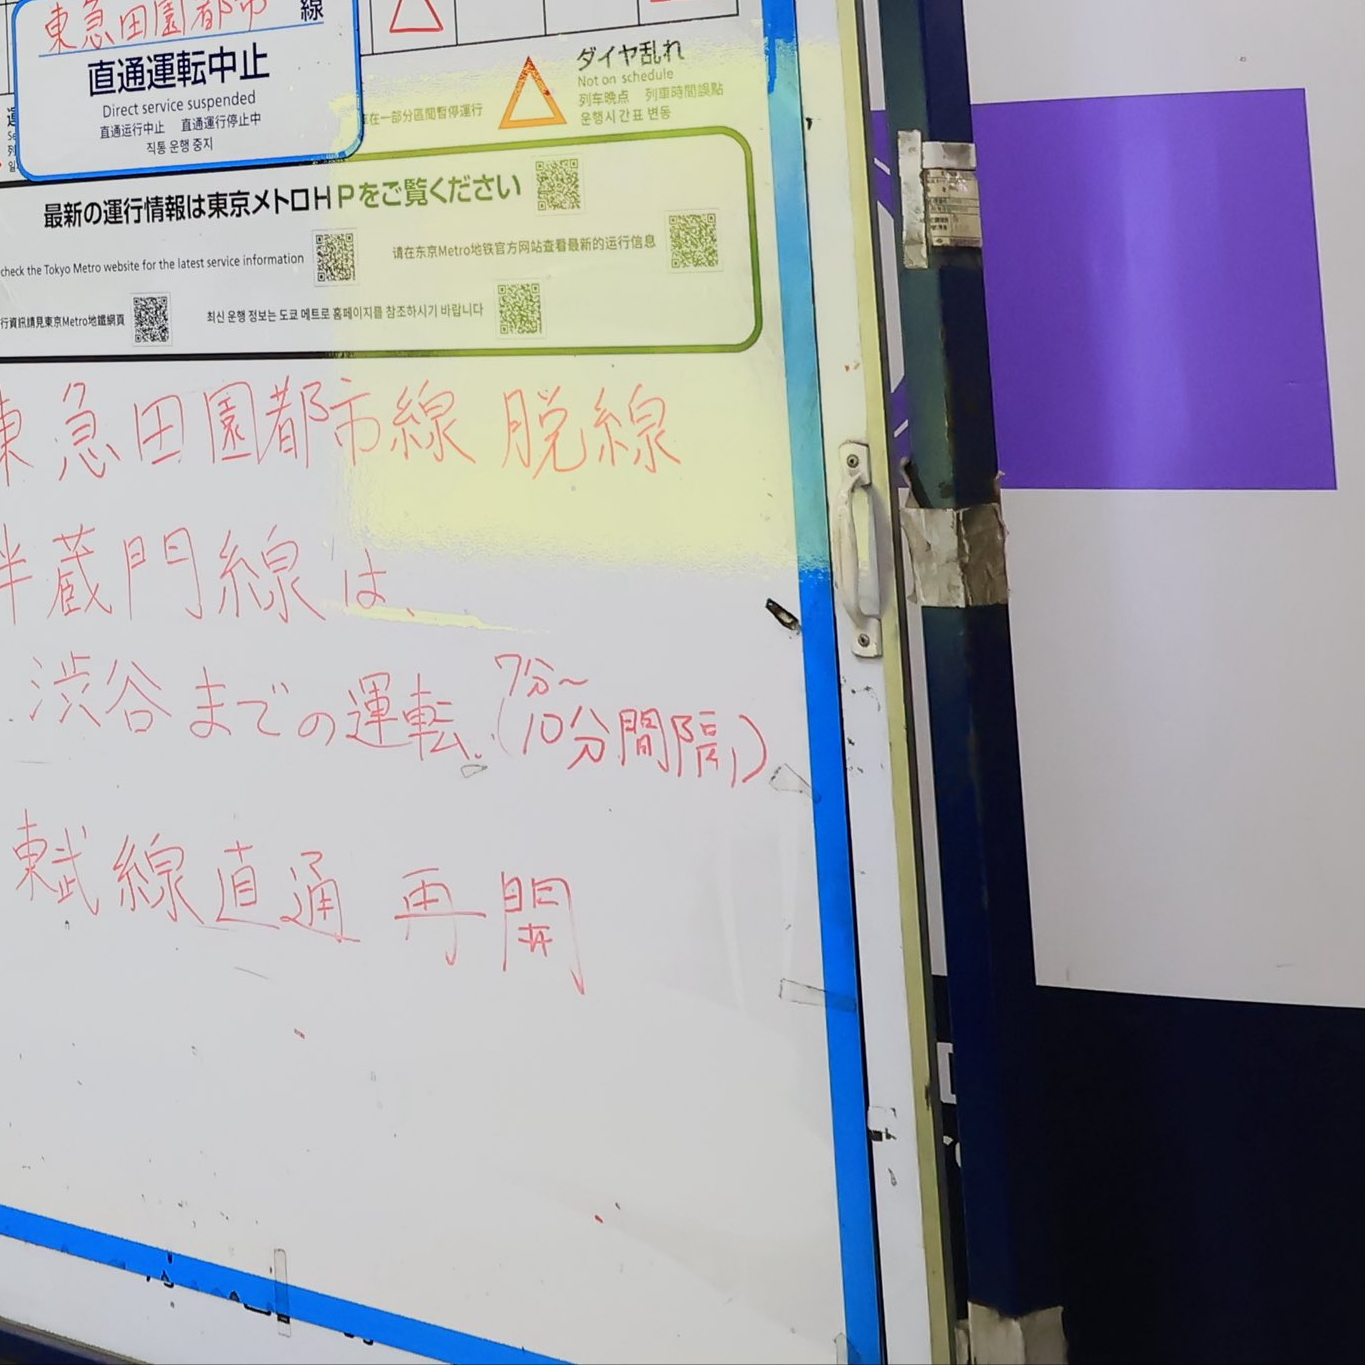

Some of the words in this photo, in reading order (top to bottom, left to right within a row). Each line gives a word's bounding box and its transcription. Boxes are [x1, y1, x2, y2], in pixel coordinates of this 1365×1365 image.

[88, 42, 270, 97] 直通運転中止
[577, 39, 685, 71] ダイヤ乱れ
[578, 74, 598, 88] Not
[601, 75, 617, 86] on
[621, 68, 674, 84] schedule
[102, 102, 138, 119] Direct
[142, 97, 184, 114] service
[187, 90, 256, 112] suspended
[100, 120, 165, 140] 直通运行中止
[180, 111, 261, 133] 直通運行停止中
[146, 141, 166, 155] 직통
[169, 138, 189, 154] 운행
[192, 137, 214, 152] 중지
[0, 265, 25, 277] check
[27, 263, 42, 276] the
[44, 263, 71, 277] Tokyo
[73, 261, 102, 274] Metro
[104, 259, 139, 272] website
[142, 258, 157, 271] for
[159, 257, 175, 270] the
[178, 256, 204, 269] latest
[207, 255, 240, 268] service
[243, 253, 305, 266] information
[206, 309, 225, 324] 최신
[227, 308, 246, 323] 운행
[248, 307, 277, 322] 정보는
[279, 307, 299, 321] 도쿄
[301, 306, 330, 321] 메트로
[333, 305, 383, 320] 홈페이지를
[385, 303, 438, 319] 참조하시기
[441, 301, 484, 318] 바랍니다
[502, 384, 683, 479] 脱線
[394, 868, 585, 995] 再開
